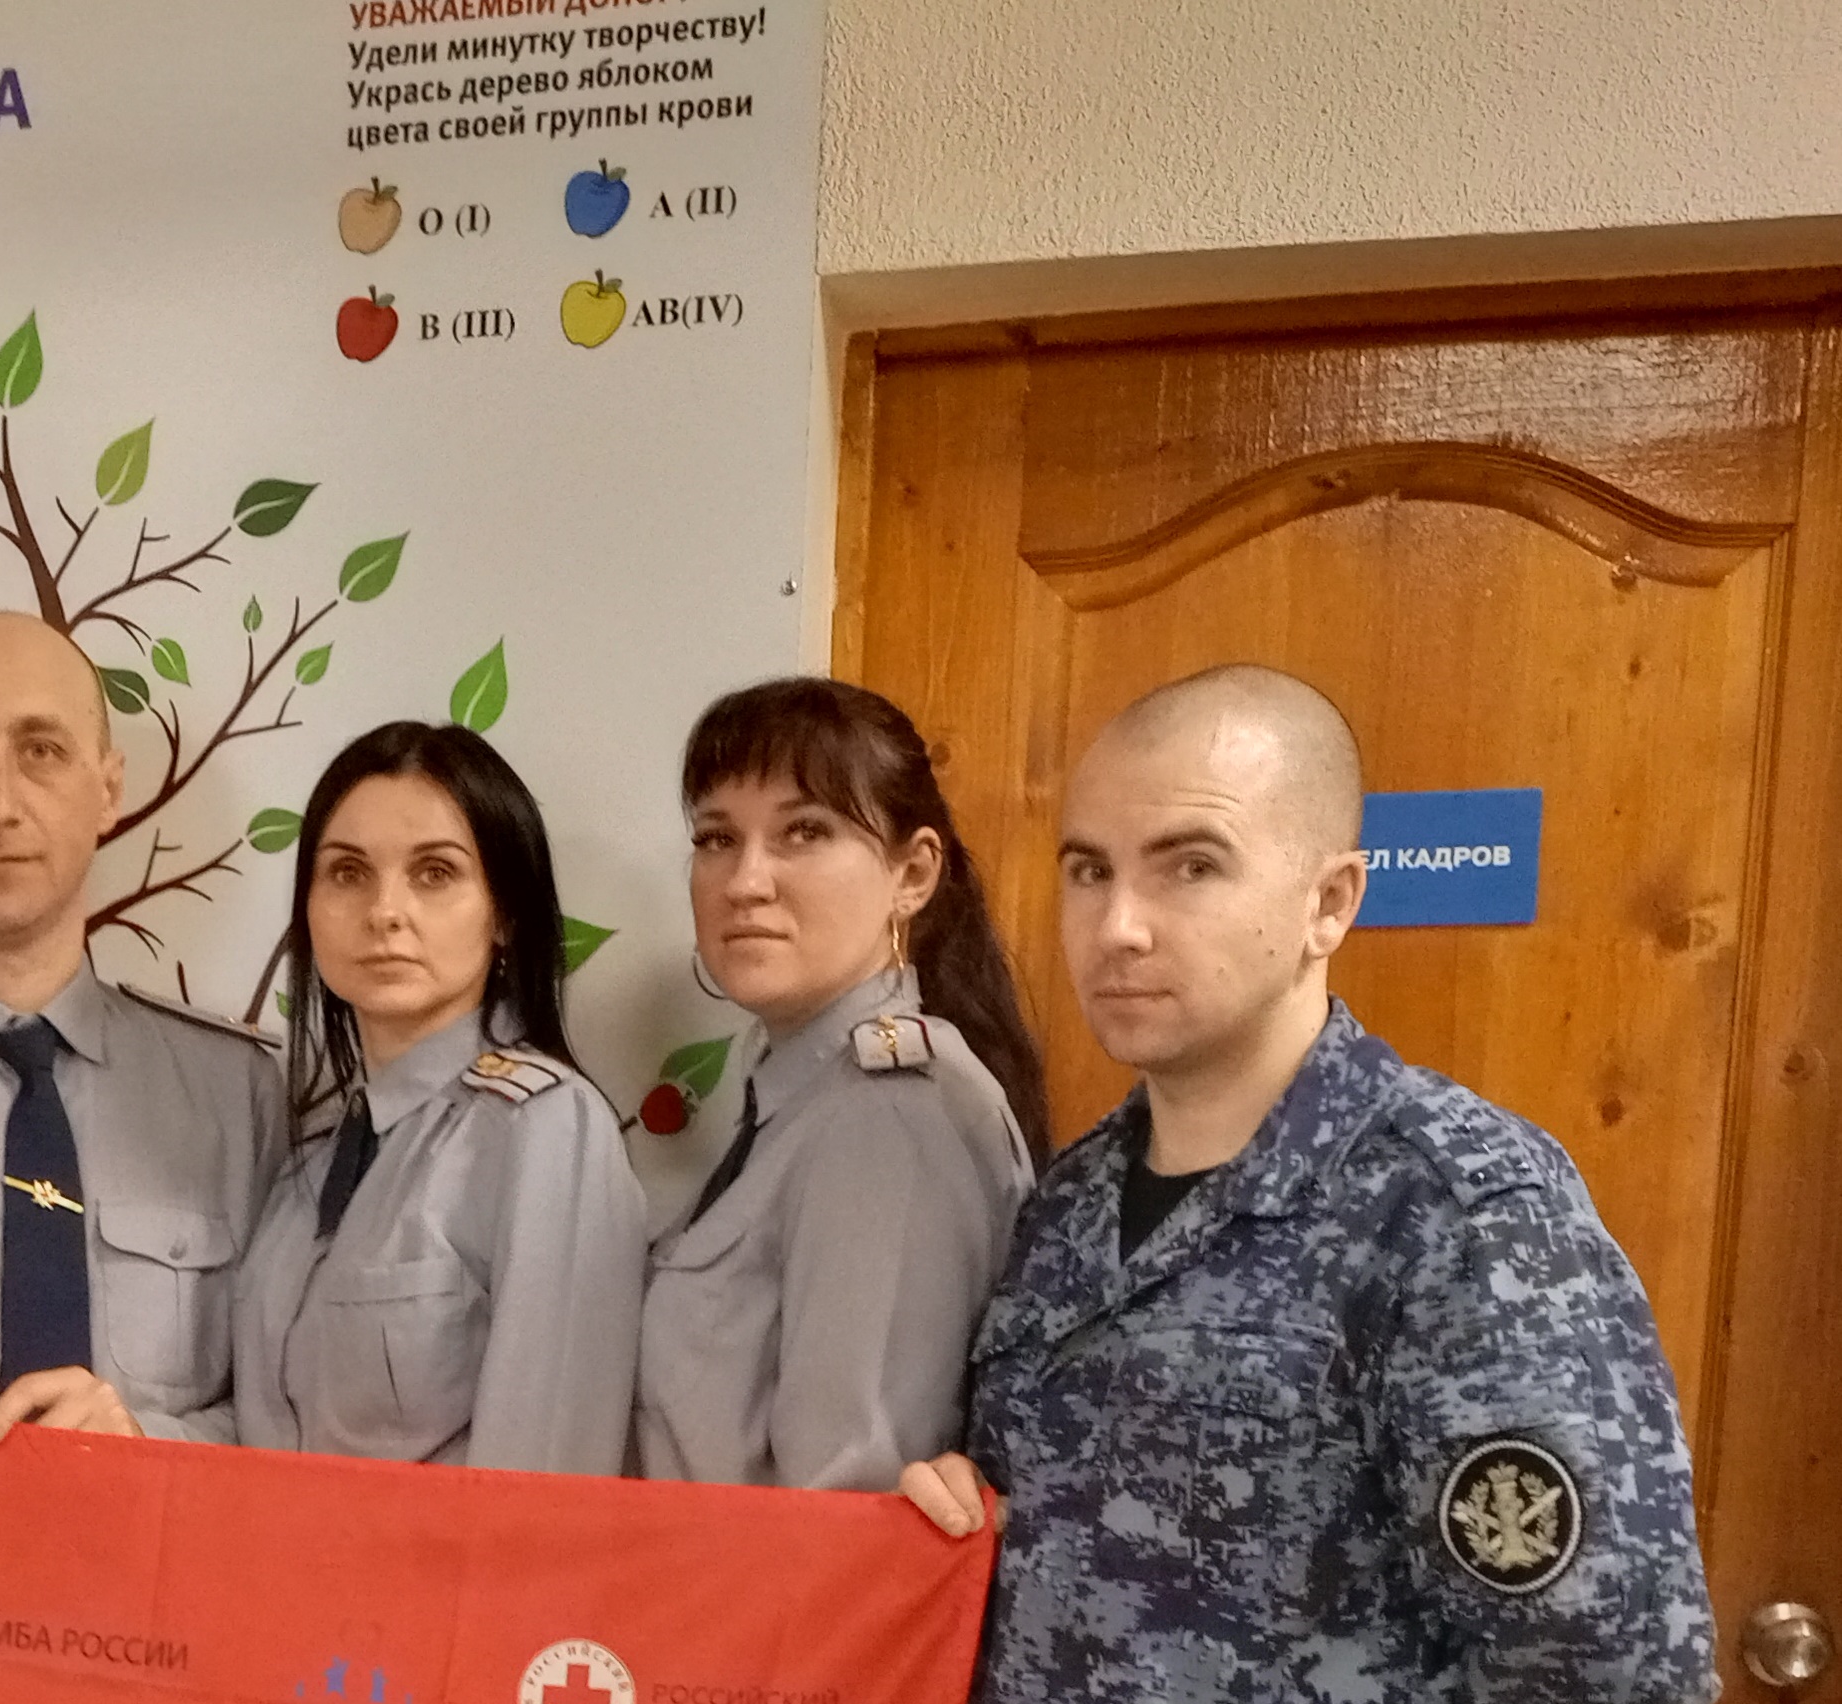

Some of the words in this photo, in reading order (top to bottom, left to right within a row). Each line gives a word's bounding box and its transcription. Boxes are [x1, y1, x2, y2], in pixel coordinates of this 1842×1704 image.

[347, 40, 438, 73] Удели
[447, 27, 575, 64] минутку
[584, 8, 767, 52] творчеству!
[346, 78, 452, 112] Укрась
[459, 68, 570, 104] дерево
[577, 57, 714, 91] яблоком
[346, 117, 429, 152] цвета
[438, 106, 526, 141] своей
[536, 101, 648, 139] группы
[658, 94, 754, 129] крови
[1397, 845, 1511, 872] КАДРОВ
[60, 1627, 190, 1672] РОССИИ
